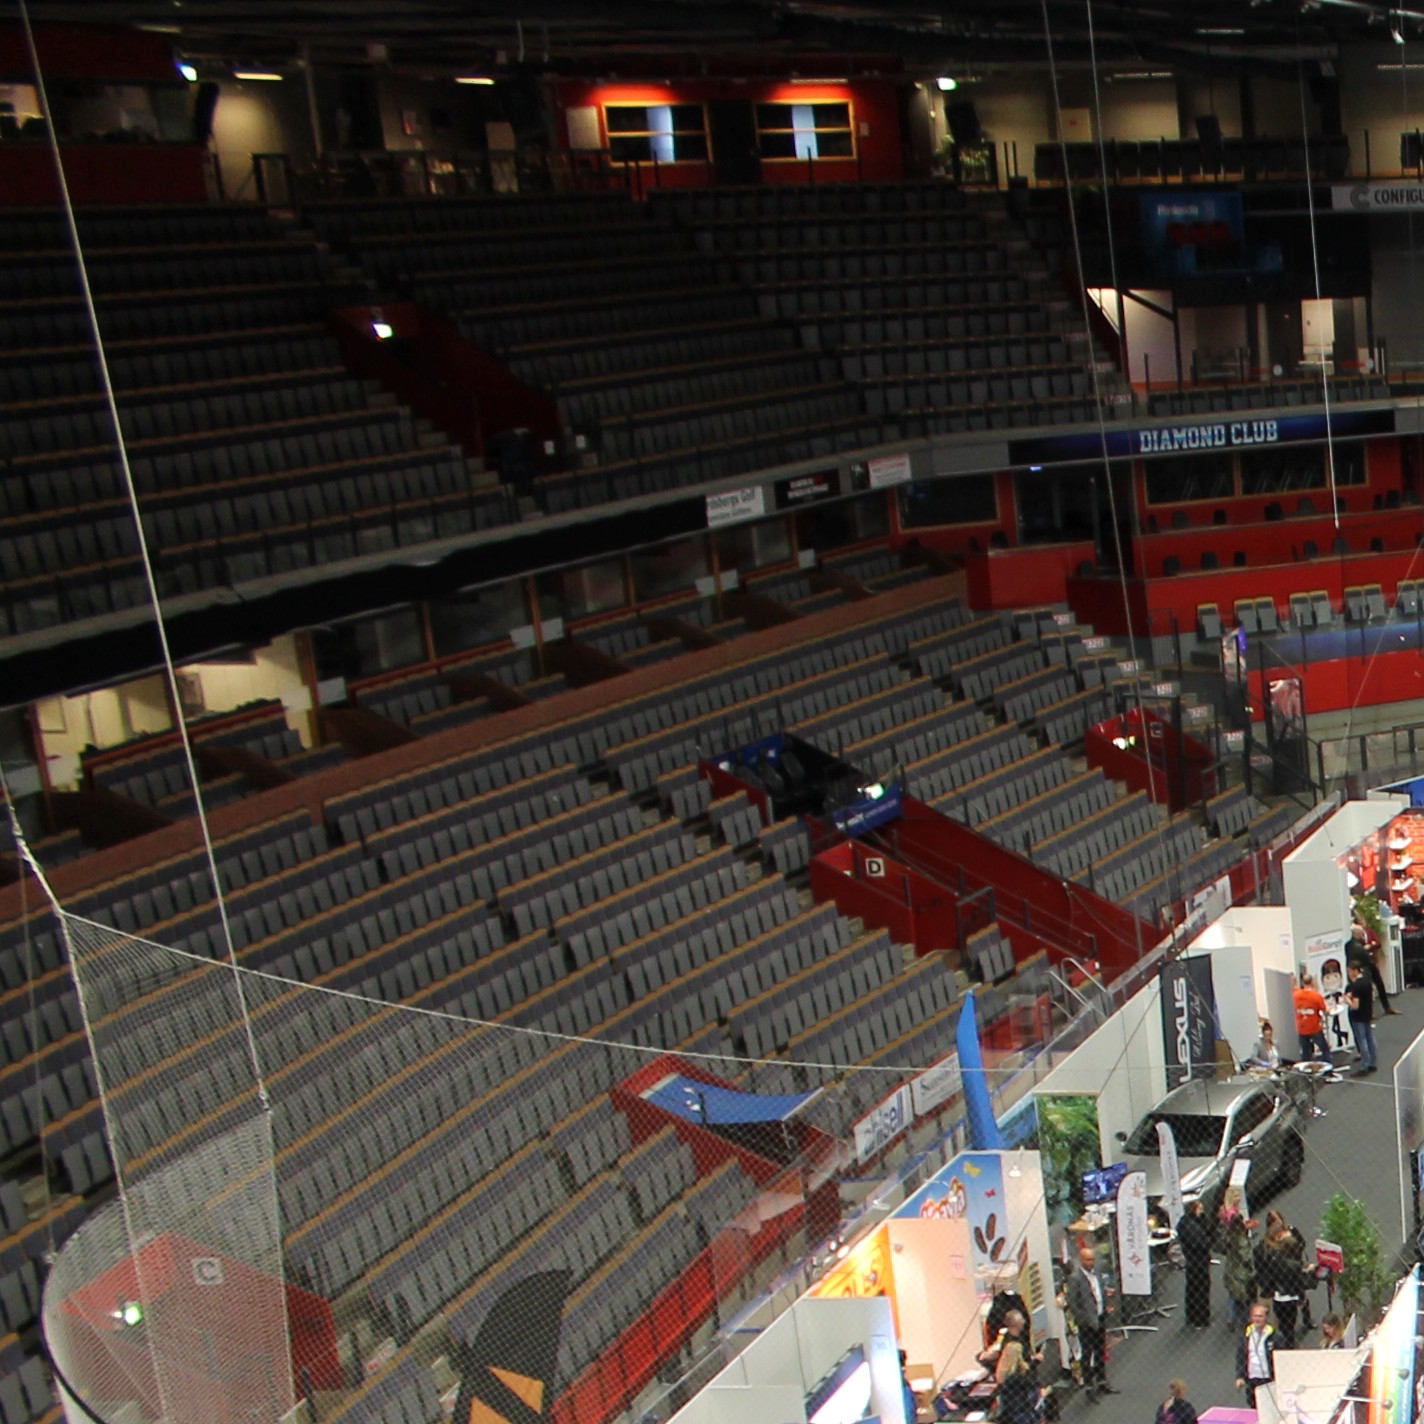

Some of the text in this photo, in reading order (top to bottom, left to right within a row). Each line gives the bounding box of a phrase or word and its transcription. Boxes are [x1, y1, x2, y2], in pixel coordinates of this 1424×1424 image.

[1139, 420, 1278, 453] DIAMOND CLUB
[869, 860, 882, 873] D
[1173, 977, 1193, 1083] LEXUS
